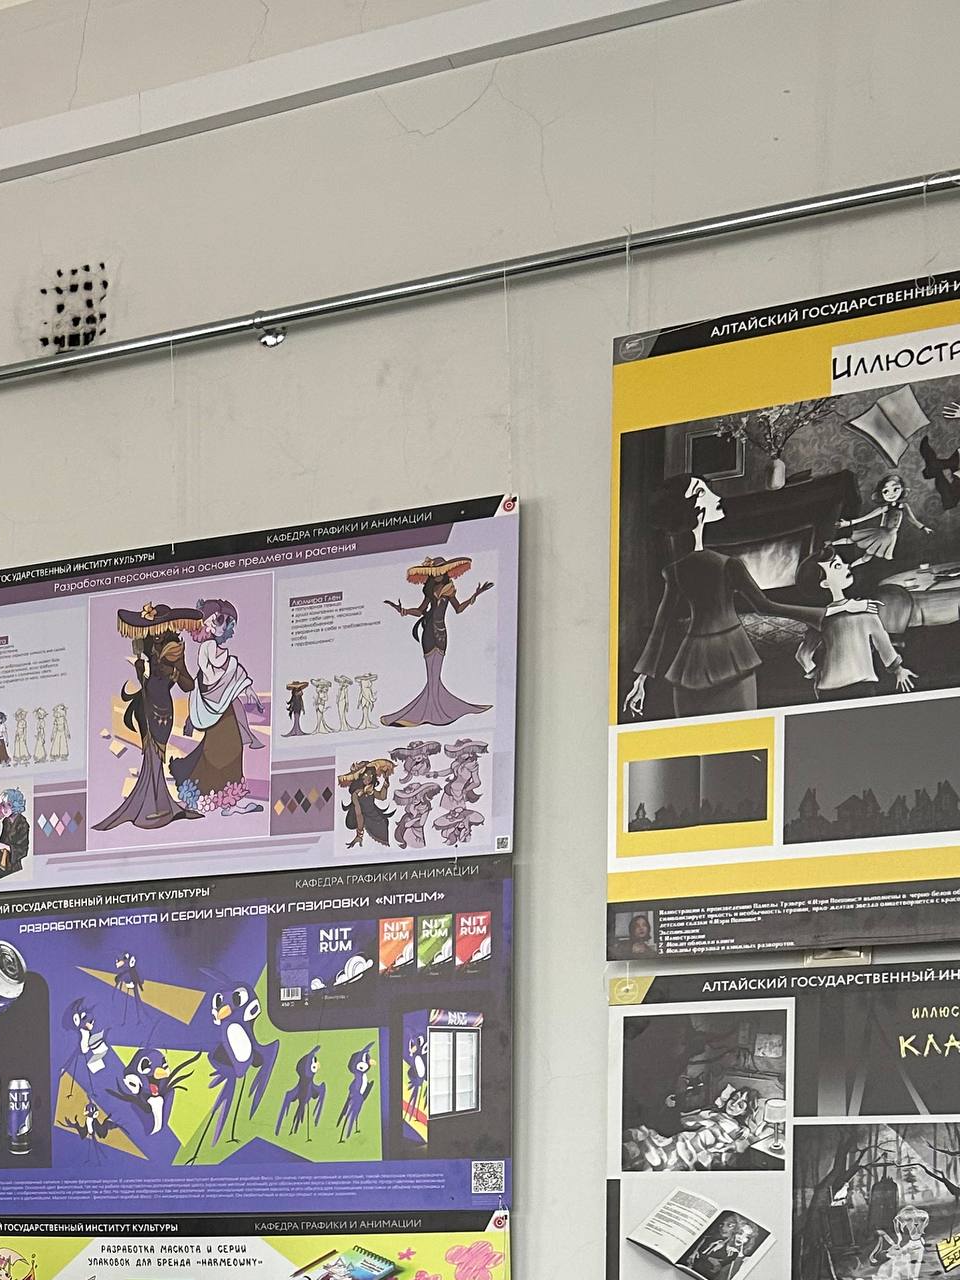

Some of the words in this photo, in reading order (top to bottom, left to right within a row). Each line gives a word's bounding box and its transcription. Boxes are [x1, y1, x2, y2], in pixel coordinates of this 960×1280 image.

[711, 310, 798, 337] АЛТАЙСКИЙ
[803, 282, 948, 319] ГОСУДАРСТВЕННЫЙ
[267, 530, 310, 544] КАФЕДРА
[313, 523, 358, 537] ГРАФИКИ
[361, 521, 368, 531] И
[371, 512, 432, 529] АНИМАЦИИ
[54, 575, 111, 594] Разработка
[114, 566, 179, 586] персонажей
[182, 566, 195, 575] на
[198, 560, 235, 573] основе
[239, 552, 292, 569] предмета
[296, 551, 302, 559] и
[306, 543, 356, 560] растения
[73, 559, 112, 573] ИНСТИТУТ
[114, 553, 155, 567] КУЛЬТУРЫ
[296, 876, 344, 888] КАФЕДРА
[347, 872, 397, 885] ГРАФИКИ
[400, 871, 408, 881] И
[411, 865, 479, 880] АНИМАЦИИ
[12, 896, 103, 913] ГОСУДАРСТВЕННЫЙ
[105, 892, 157, 905] ИНСТИТУТ
[159, 888, 210, 901] КУЛЬТУРЫ
[19, 919, 96, 934] РАЗРАБОТКА
[99, 914, 157, 928] МАСКОТА
[159, 913, 168, 923] И
[171, 910, 213, 922] СЕРИИ
[216, 904, 286, 919] УПАКОВКИ
[288, 897, 369, 913] ГАЗИРОВКИ
[376, 891, 444, 907] «NITRUM»
[384, 921, 408, 931] NIT
[423, 919, 446, 929] NIT
[460, 915, 487, 926] NIT
[320, 928, 352, 941] NIT
[384, 930, 409, 940] RUM
[423, 928, 447, 938] RUM
[461, 926, 486, 935] RUM
[320, 941, 352, 952] RUM
[702, 977, 787, 992] АЛТАЙСКИЙ
[791, 970, 934, 988] ГОСУДАРСТВЕННЫЙ
[448, 1011, 466, 1019] NIT
[10, 1092, 29, 1101] NIT
[9, 1101, 29, 1110] RUM
[4, 1223, 83, 1232] ГОСУДАРСТВЕННЫЙ
[86, 1223, 130, 1231] ИНСТИТУТ
[132, 1223, 178, 1232] КУЛЬТУРЫ
[255, 1222, 298, 1230] КАФЕДРА
[301, 1221, 347, 1229] ГРАФИКИ
[360, 1219, 422, 1228] АНИМАЦИИ
[101, 1245, 155, 1253] РАЗРАБОТКА
[161, 1245, 201, 1253] МАСКОТА
[218, 1245, 247, 1253] СЕРИИ
[88, 1258, 130, 1267] УПАКОВОК
[136, 1258, 152, 1267] ДЛЯ
[157, 1258, 190, 1267] БРЕНДА
